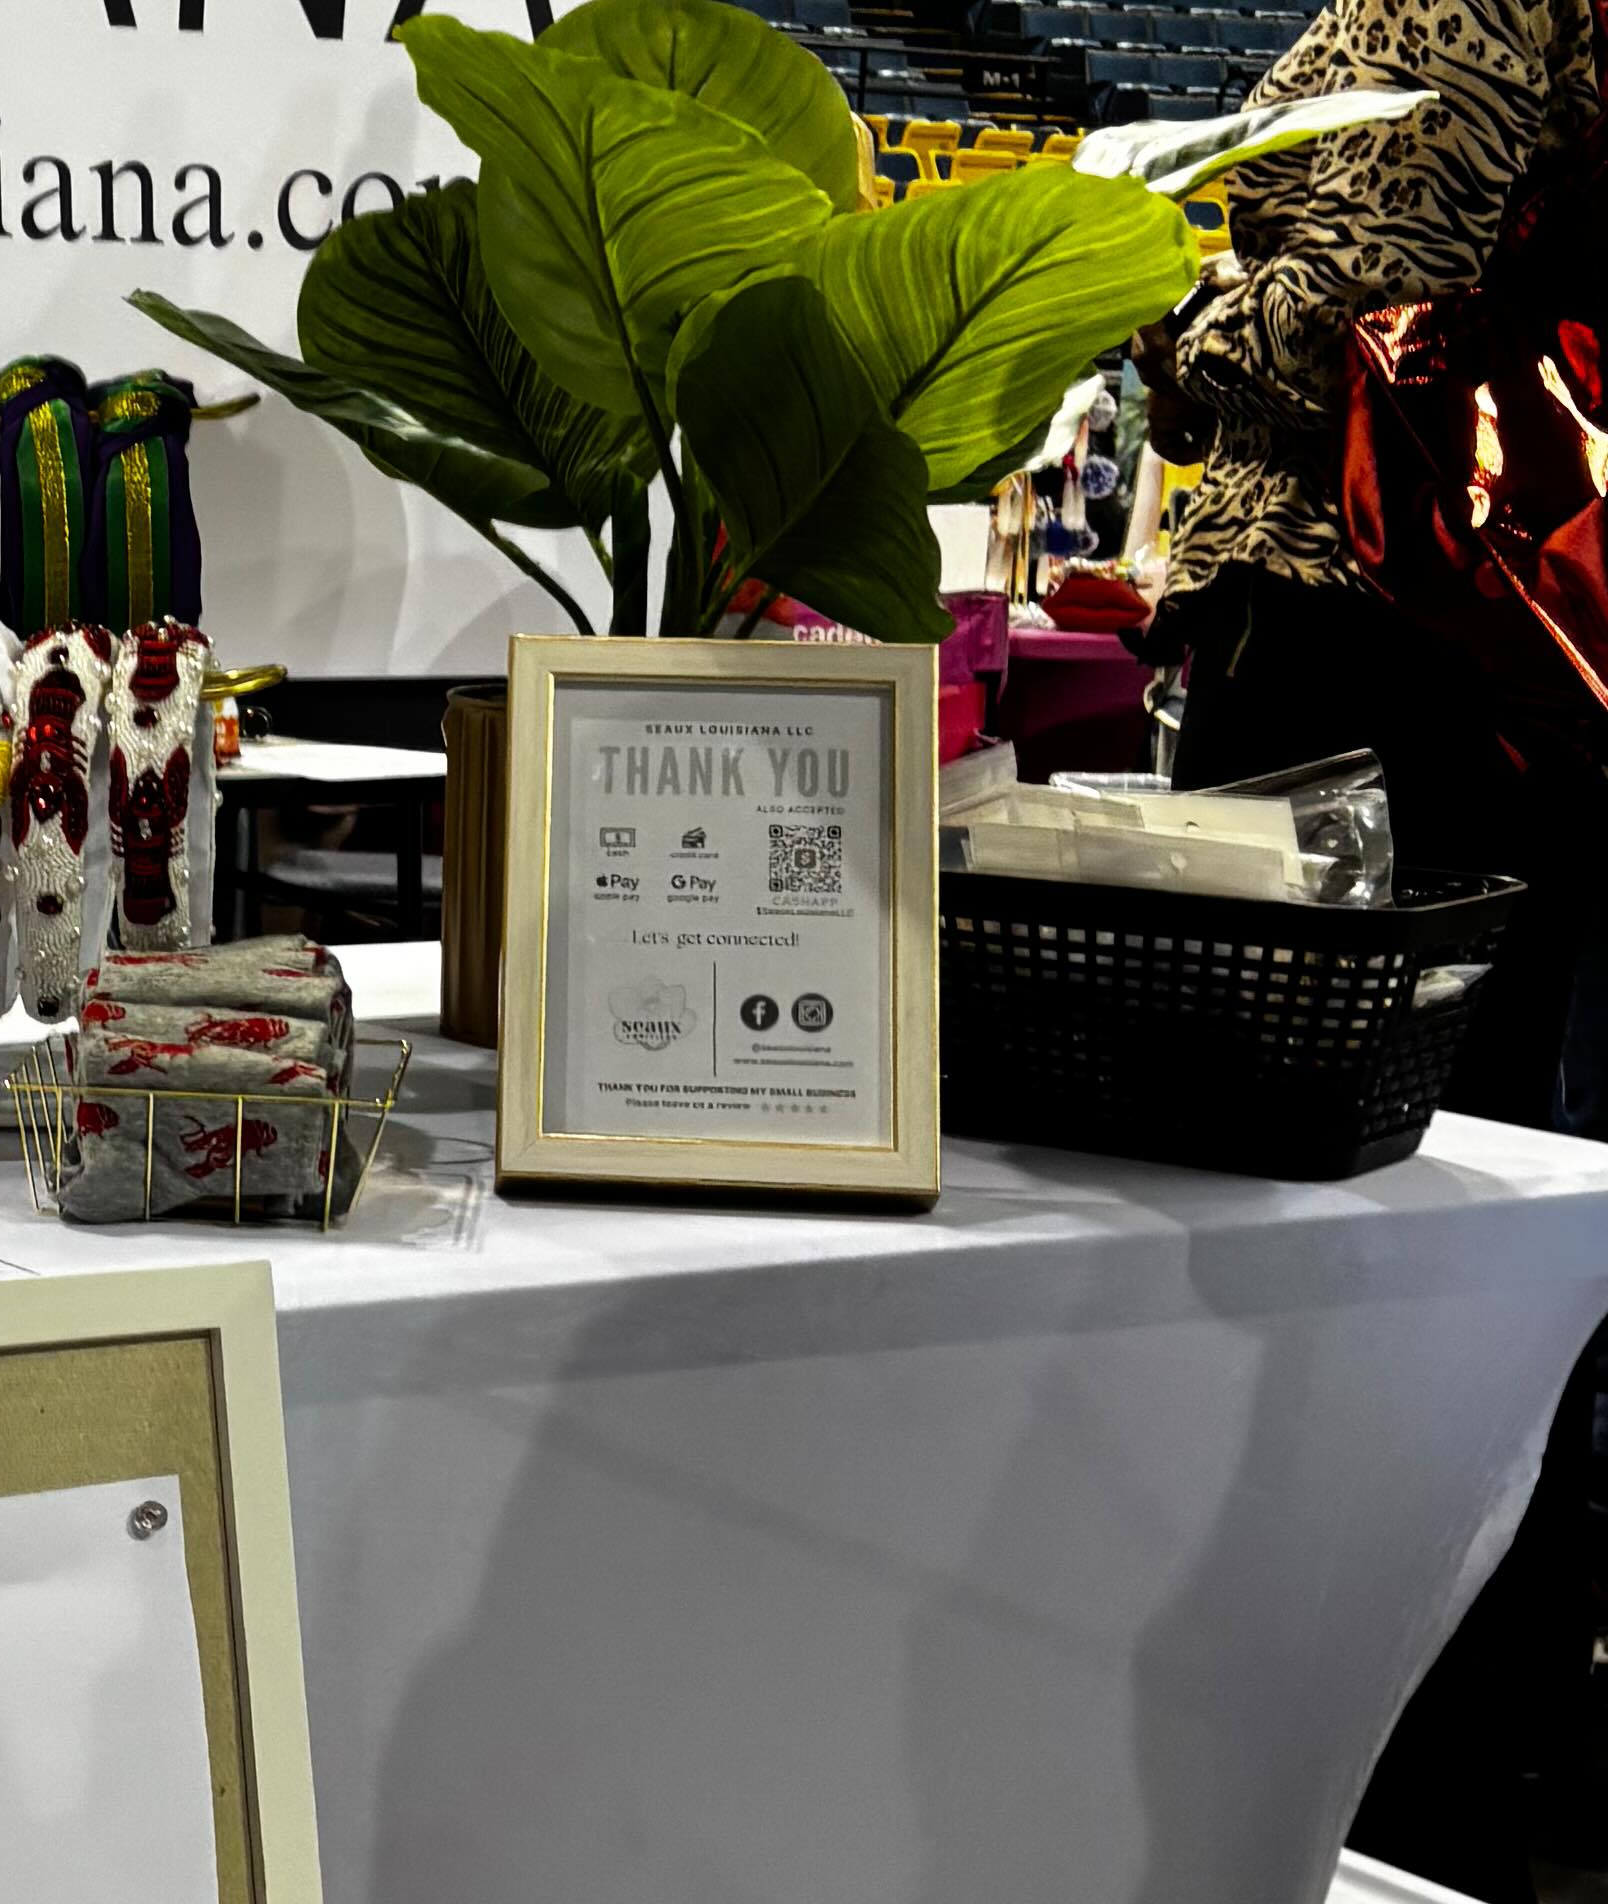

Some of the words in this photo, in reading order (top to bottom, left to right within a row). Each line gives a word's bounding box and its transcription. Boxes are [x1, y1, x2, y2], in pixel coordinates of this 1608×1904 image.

[645, 724, 693, 735] SEAUX
[700, 724, 780, 736] LOUISIANA
[787, 726, 813, 736] LLC
[598, 746, 745, 796] THANK
[767, 747, 850, 797] YOU
[788, 805, 845, 815] ACCEPTED
[610, 874, 640, 891] Pay
[690, 876, 717, 892] Pay
[632, 929, 669, 945] Let's
[677, 932, 702, 948] get
[706, 931, 800, 948] connected!
